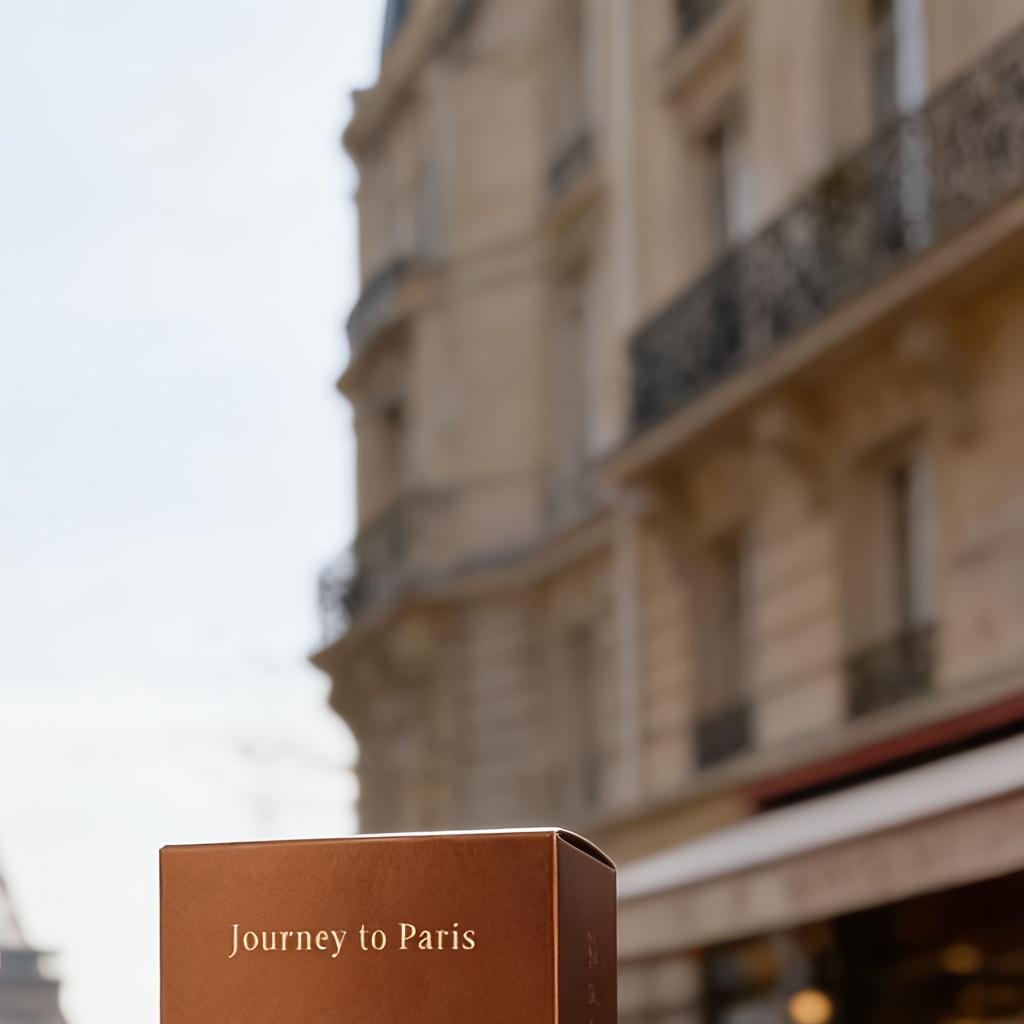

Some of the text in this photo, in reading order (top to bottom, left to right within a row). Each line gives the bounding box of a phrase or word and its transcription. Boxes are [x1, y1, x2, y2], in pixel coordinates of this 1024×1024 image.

[228, 922, 476, 958] Journey to Paris
